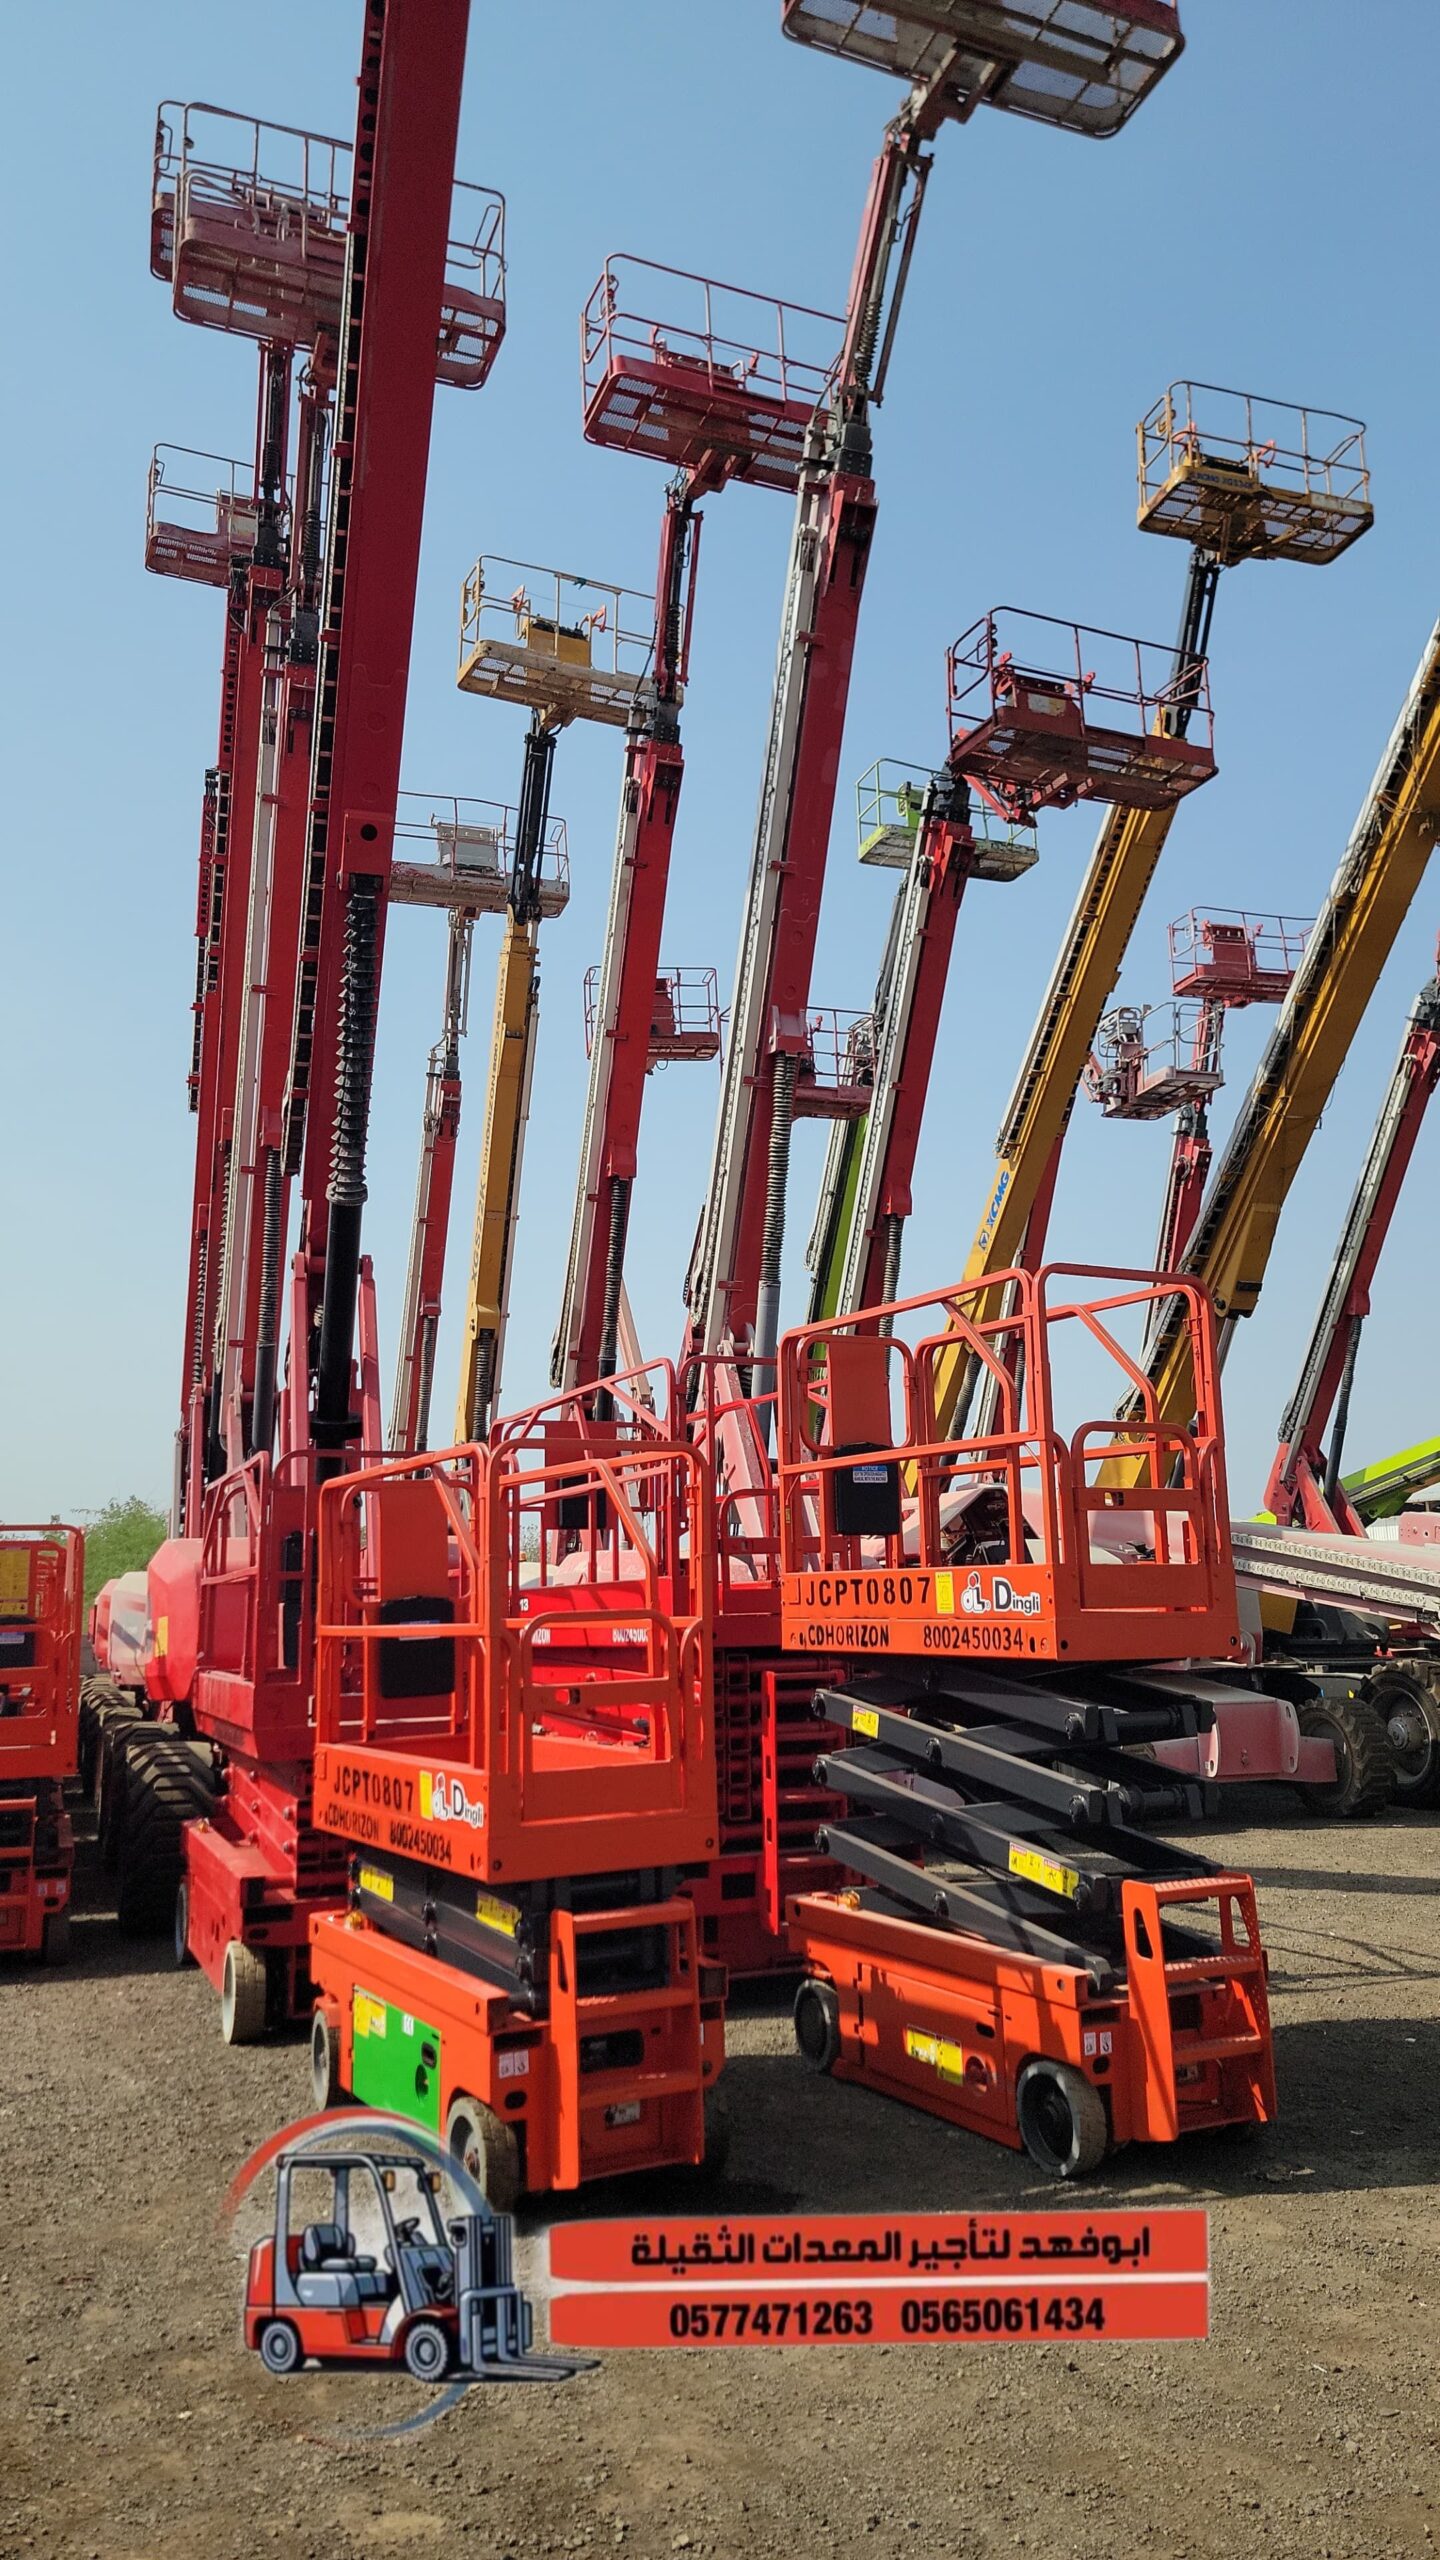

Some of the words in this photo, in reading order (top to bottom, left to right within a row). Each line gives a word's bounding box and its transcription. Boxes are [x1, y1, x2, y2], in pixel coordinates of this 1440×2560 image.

[986, 1170, 1009, 1229] XCMG
[806, 1576, 930, 1606] JCPT0807
[994, 1579, 1040, 1614] Dingli
[808, 1624, 890, 1648] CDHORIZON
[923, 1624, 1024, 1652] 8002450034
[334, 1766, 414, 1812] JCPT0807
[453, 1783, 483, 1826] Dingli
[389, 1821, 452, 1865] 8002450034
